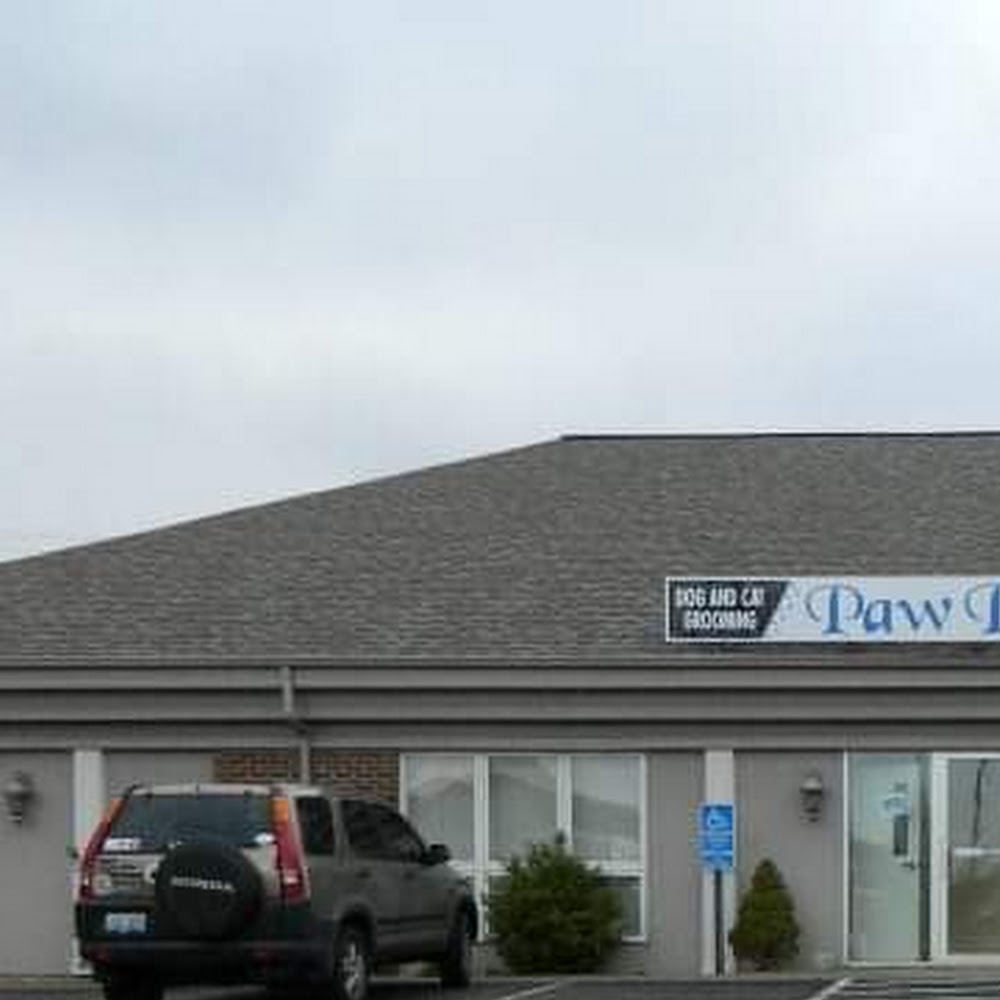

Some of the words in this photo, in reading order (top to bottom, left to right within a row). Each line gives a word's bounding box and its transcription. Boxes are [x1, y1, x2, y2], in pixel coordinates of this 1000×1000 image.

[675, 587, 706, 607] DOG
[709, 587, 737, 606] AND
[804, 583, 953, 634] Paw
